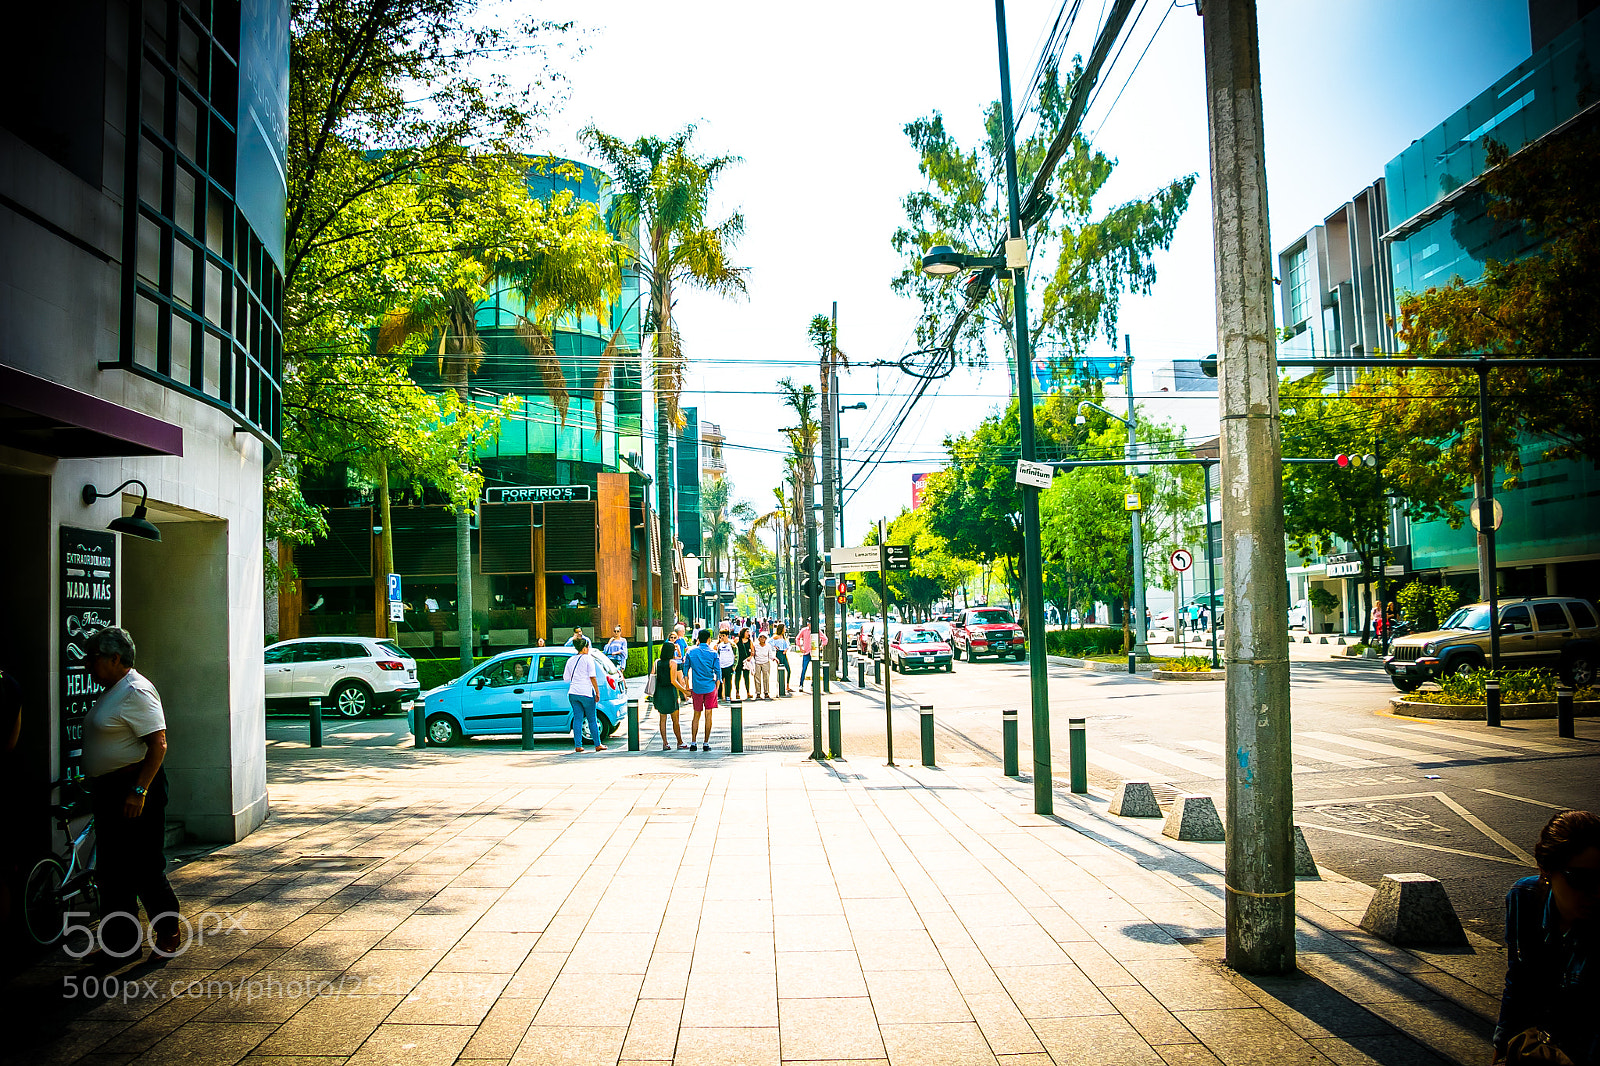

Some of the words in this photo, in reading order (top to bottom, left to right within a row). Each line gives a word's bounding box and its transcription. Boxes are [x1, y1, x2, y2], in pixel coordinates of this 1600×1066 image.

[1019, 466, 1051, 479] infinitum
[66, 552, 111, 567] EXTRAORDINARIO
[66, 581, 90, 599] NADA
[92, 579, 111, 600] MÁS
